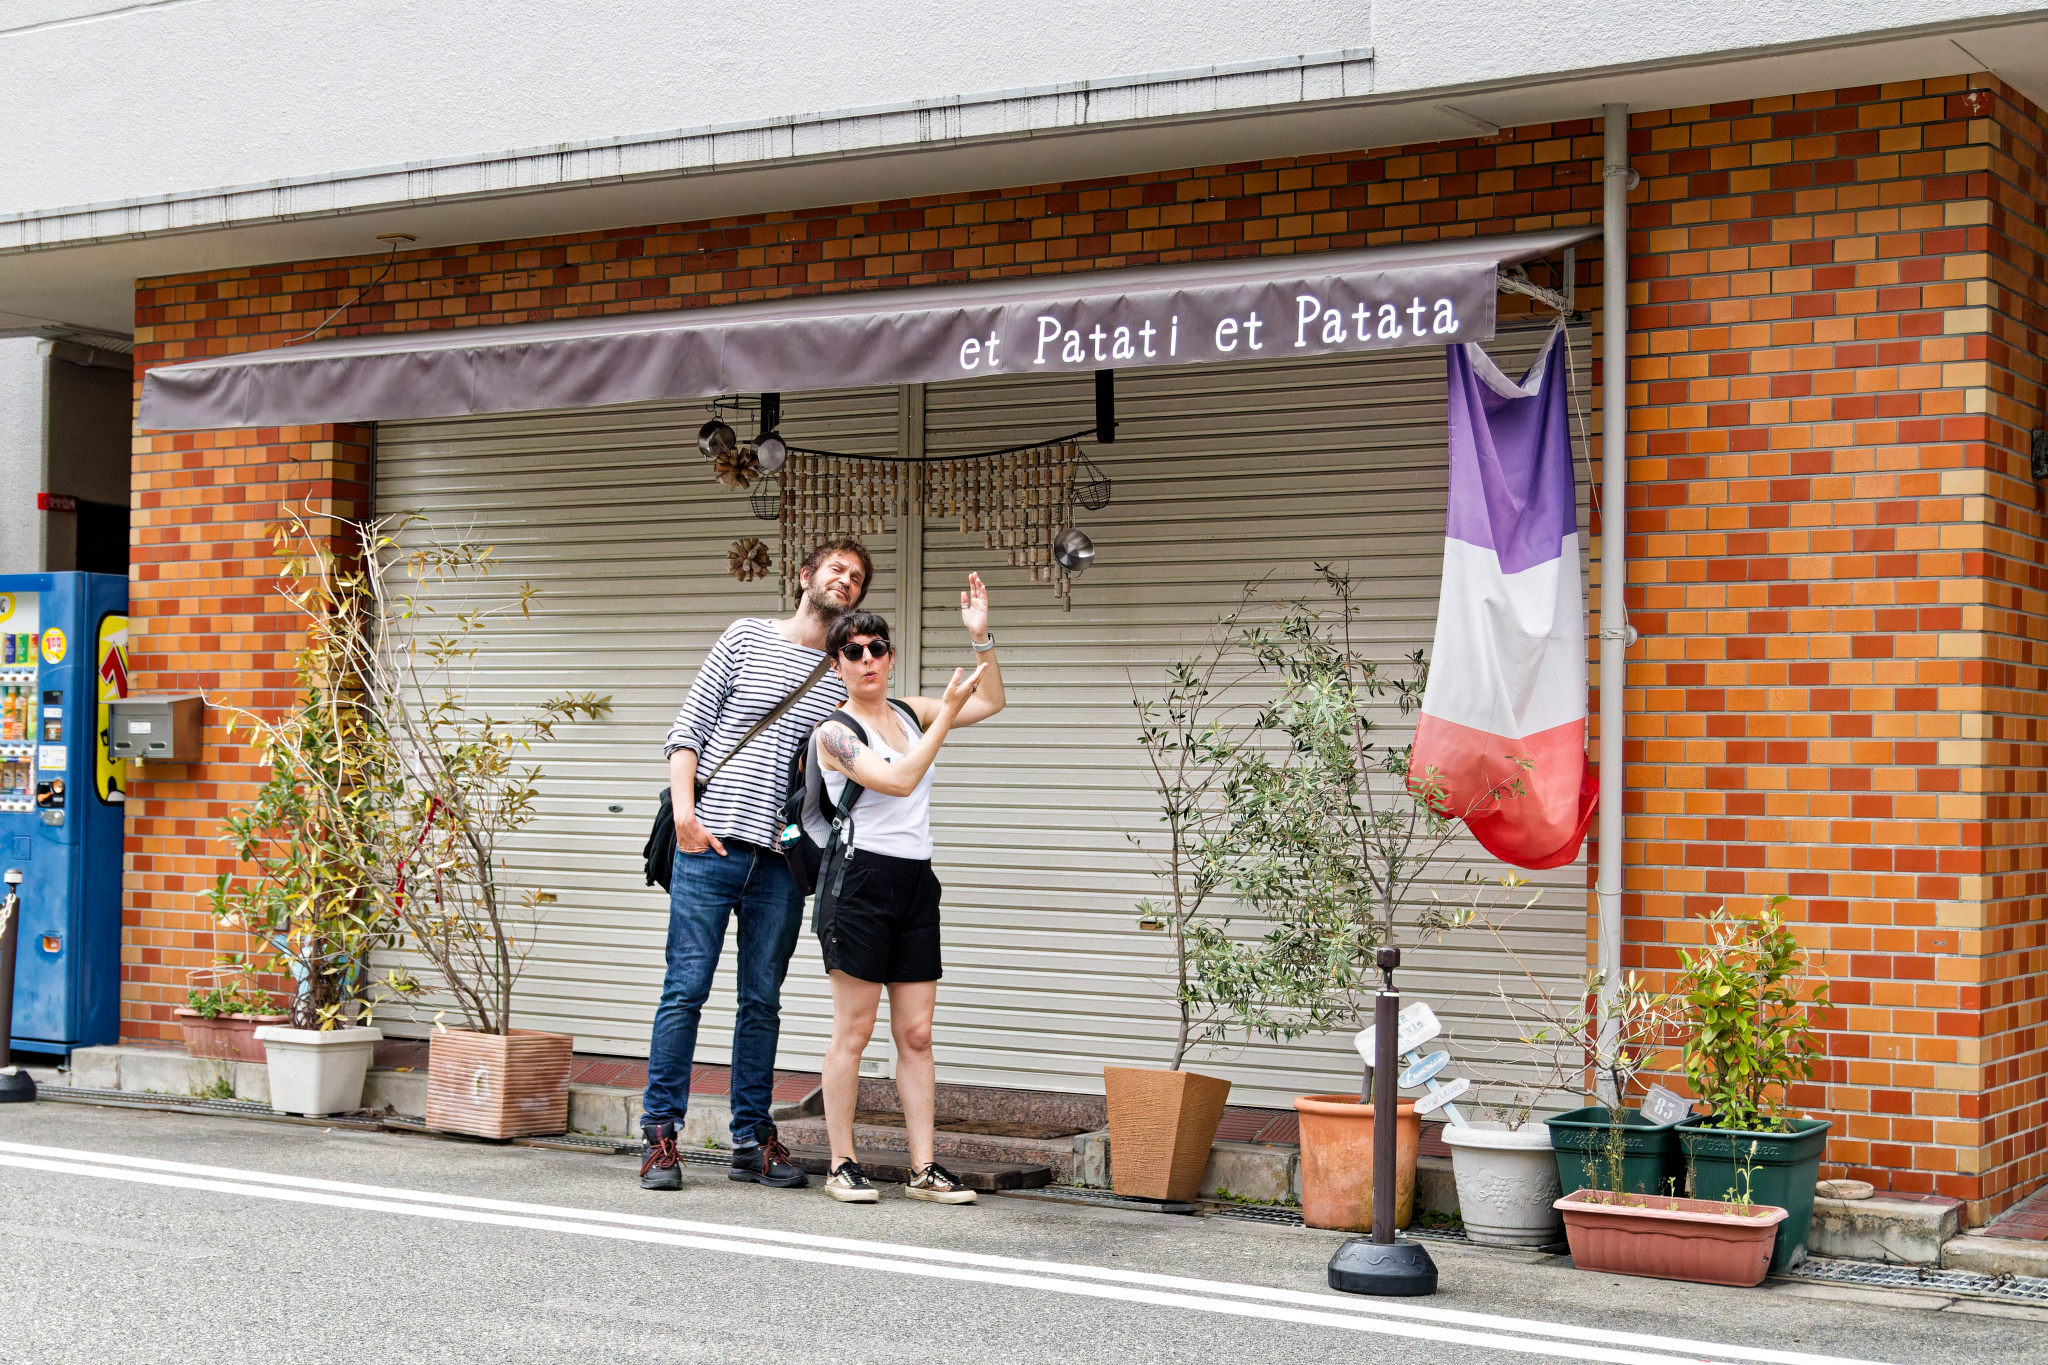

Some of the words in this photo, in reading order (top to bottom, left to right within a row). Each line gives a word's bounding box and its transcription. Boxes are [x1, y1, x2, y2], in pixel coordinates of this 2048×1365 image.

[958, 331, 1001, 371] et
[1032, 315, 1178, 366] Patati
[1214, 310, 1264, 352] et
[1293, 294, 1460, 349] Patata
